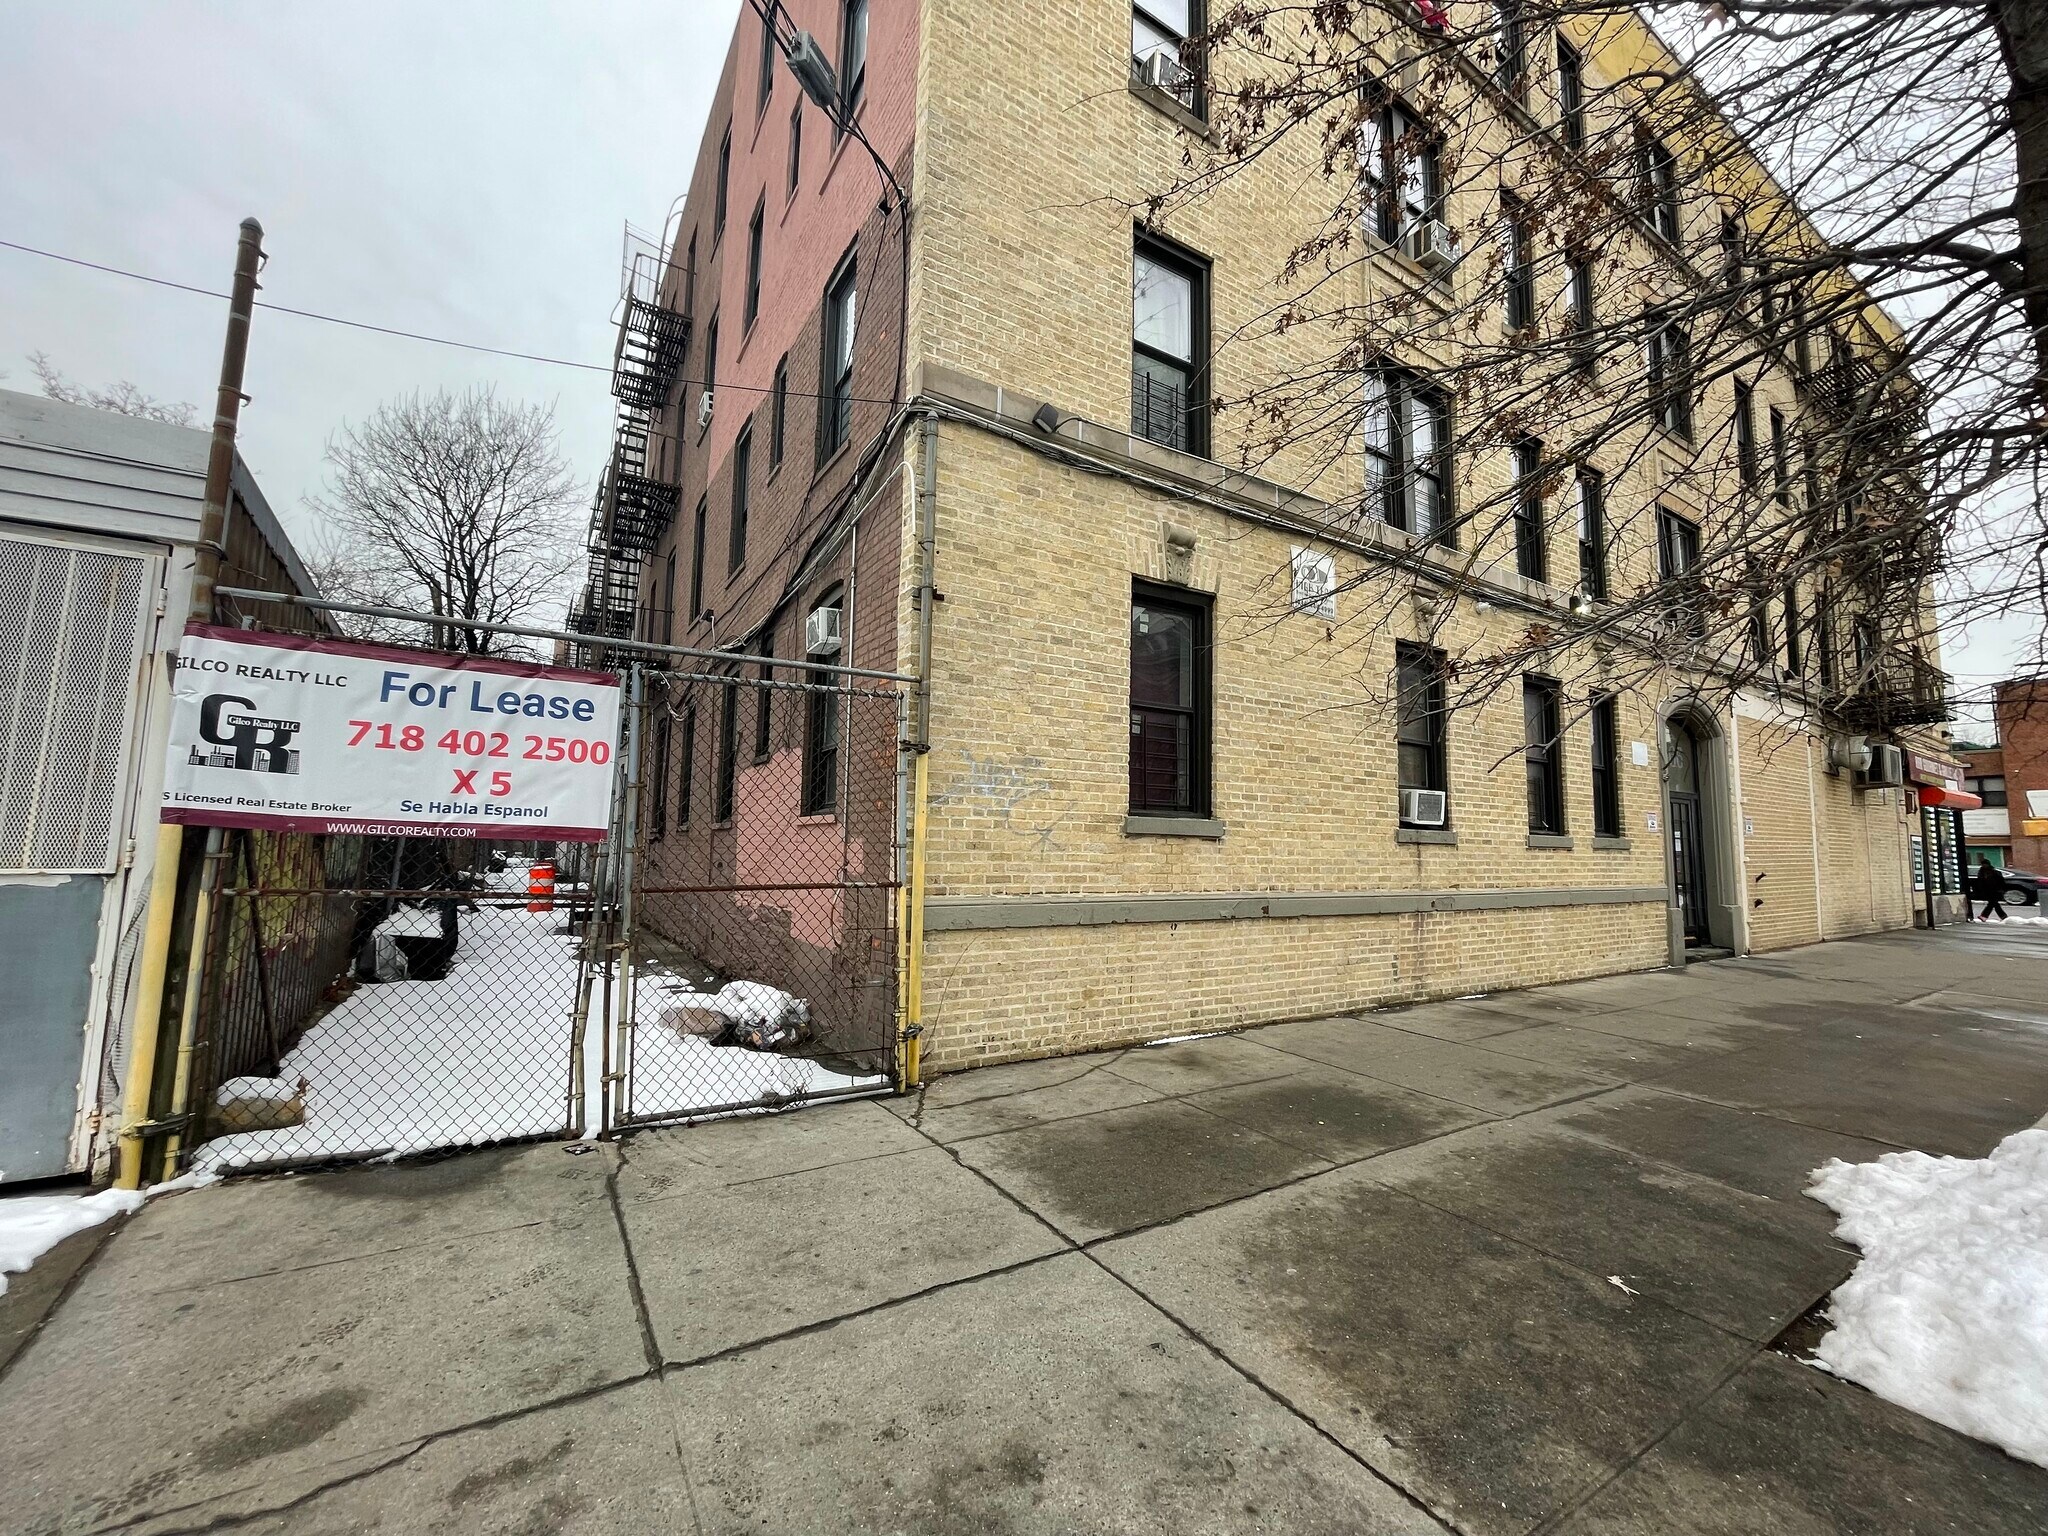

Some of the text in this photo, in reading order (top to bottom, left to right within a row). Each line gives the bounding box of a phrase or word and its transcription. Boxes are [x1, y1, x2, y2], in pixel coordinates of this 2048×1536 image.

[235, 664, 310, 683] REALTY
[314, 673, 348, 687] LLC
[380, 670, 595, 722] For Lease
[228, 715, 299, 731] Gilco Realty LLC
[347, 720, 610, 765] 718 402 2500
[450, 769, 513, 797] X 5
[174, 792, 233, 805] Licensed
[236, 797, 265, 807] Real
[268, 800, 308, 811] Estate
[311, 803, 352, 812] Broker
[400, 800, 549, 819] Se Habla Espanol
[326, 822, 477, 838] WWW.GILCOREALTY.COM
